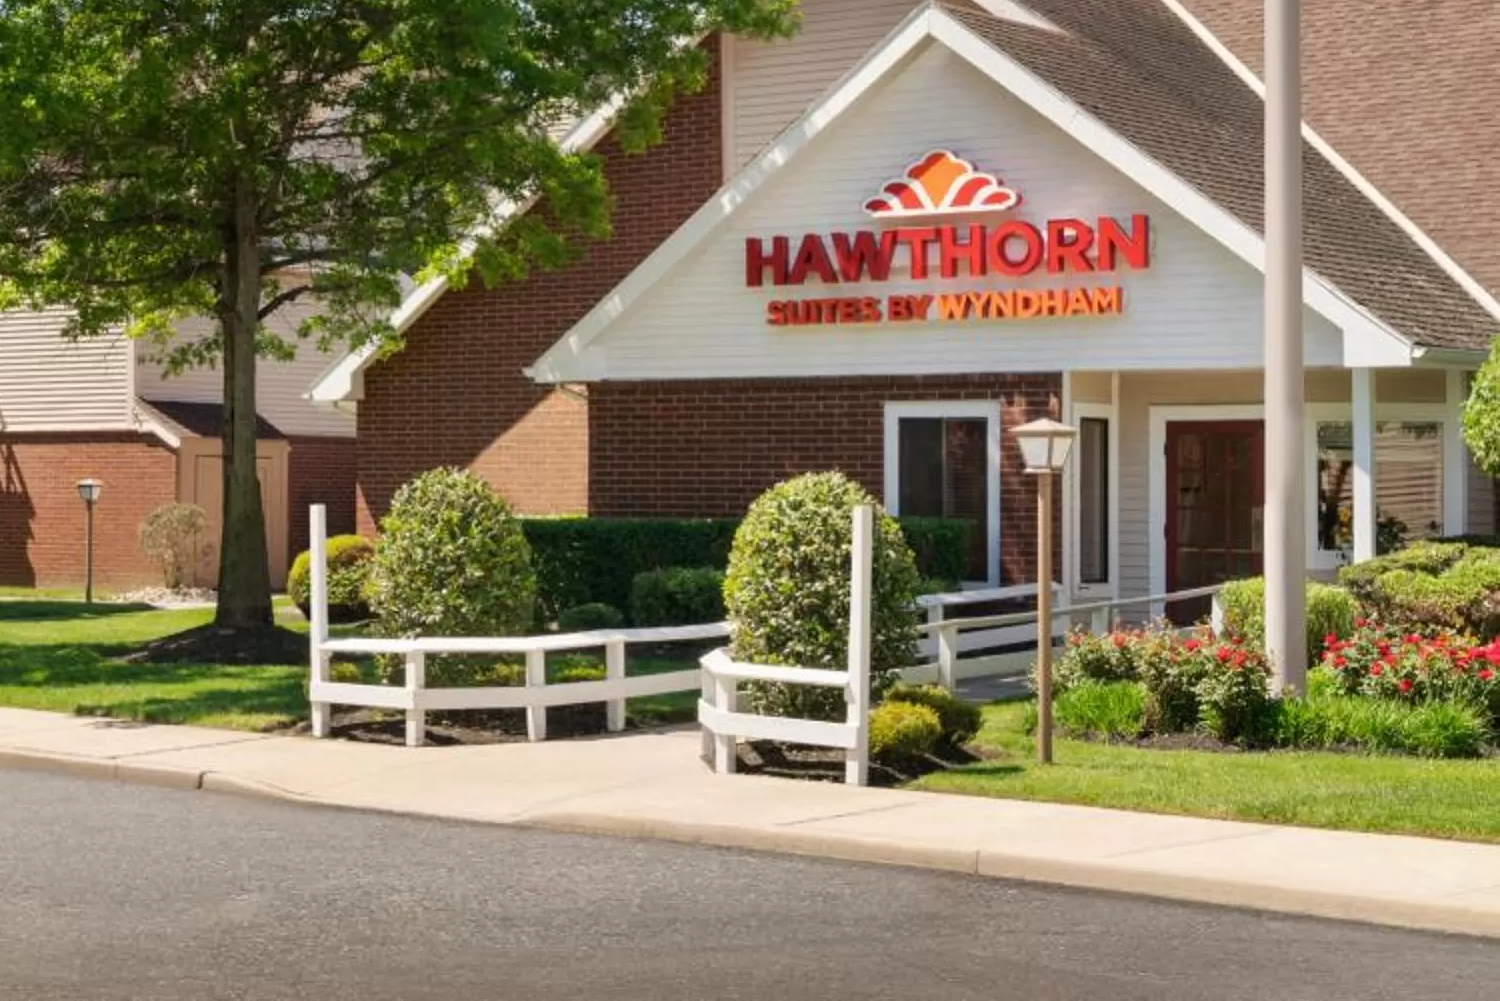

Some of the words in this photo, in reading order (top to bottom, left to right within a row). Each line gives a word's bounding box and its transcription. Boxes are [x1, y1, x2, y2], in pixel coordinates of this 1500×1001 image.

[746, 214, 1150, 287] HAWTHORN
[766, 296, 881, 325] SUITES
[888, 295, 935, 321] BY
[937, 287, 1123, 320] WYNDHAM
